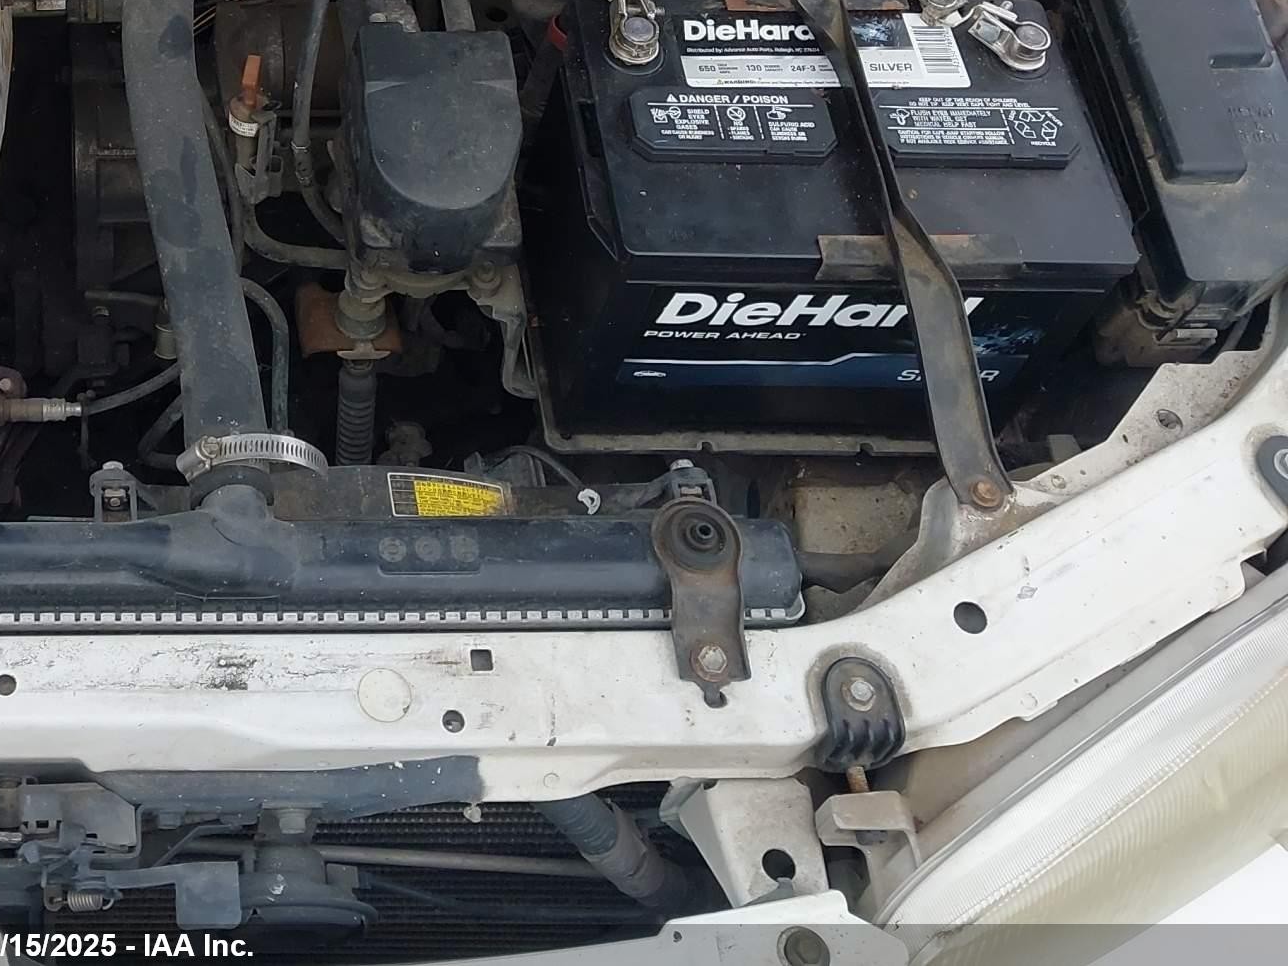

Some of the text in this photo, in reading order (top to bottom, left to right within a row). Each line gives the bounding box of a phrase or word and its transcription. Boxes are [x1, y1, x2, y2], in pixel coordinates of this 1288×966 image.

[869, 63, 912, 72] SILVER
[679, 94, 789, 104] DANGER / POISON
[644, 330, 801, 340] POWER AHEAD
